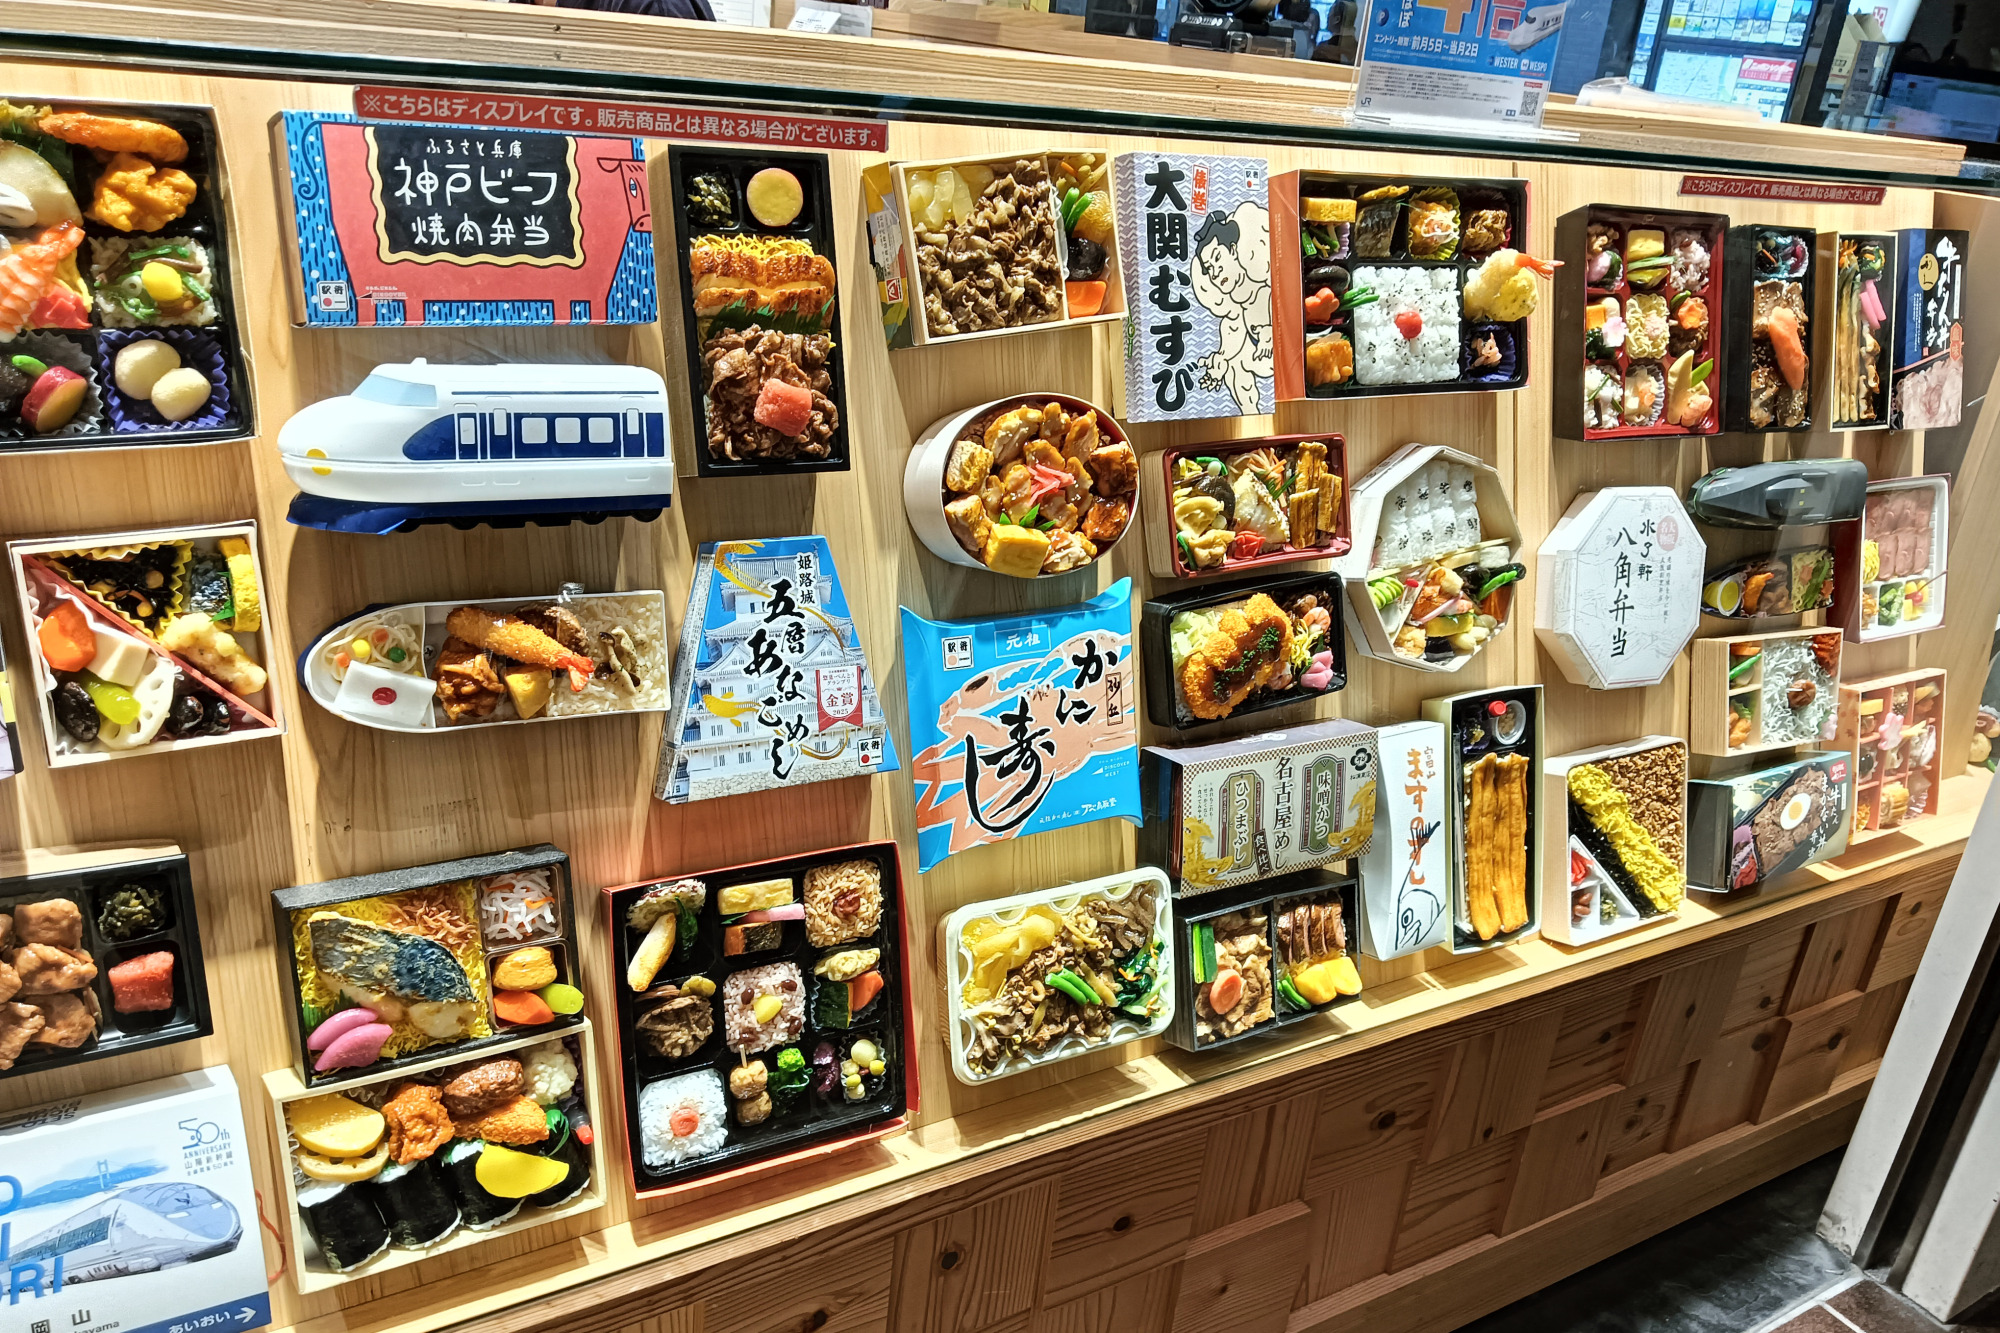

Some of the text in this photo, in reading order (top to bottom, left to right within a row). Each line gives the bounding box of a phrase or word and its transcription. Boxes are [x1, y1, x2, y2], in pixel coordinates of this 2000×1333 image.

[1494, 56, 1519, 69] WESTER
[426, 137, 523, 159] ふるさと兵庫
[394, 160, 557, 206] 神戸ビーフ
[411, 215, 551, 248] 焼肉弁当
[1145, 161, 1199, 412] 大関むすび
[1638, 519, 1656, 582] 水了軒
[797, 553, 815, 605] 姫路城
[1609, 527, 1637, 658] 八角弁当
[1006, 632, 1041, 651] 元祖
[826, 692, 854, 708] 金賞
[1234, 781, 1249, 862] ひつまぶし
[1273, 757, 1295, 870] 名古屋めし
[1316, 771, 1331, 838] 味噌かつ
[1255, 834, 1271, 874] 食べ比べ
[184, 1143, 231, 1159] ANNIVERSARY
[168, 1311, 231, 1333] あいおい
